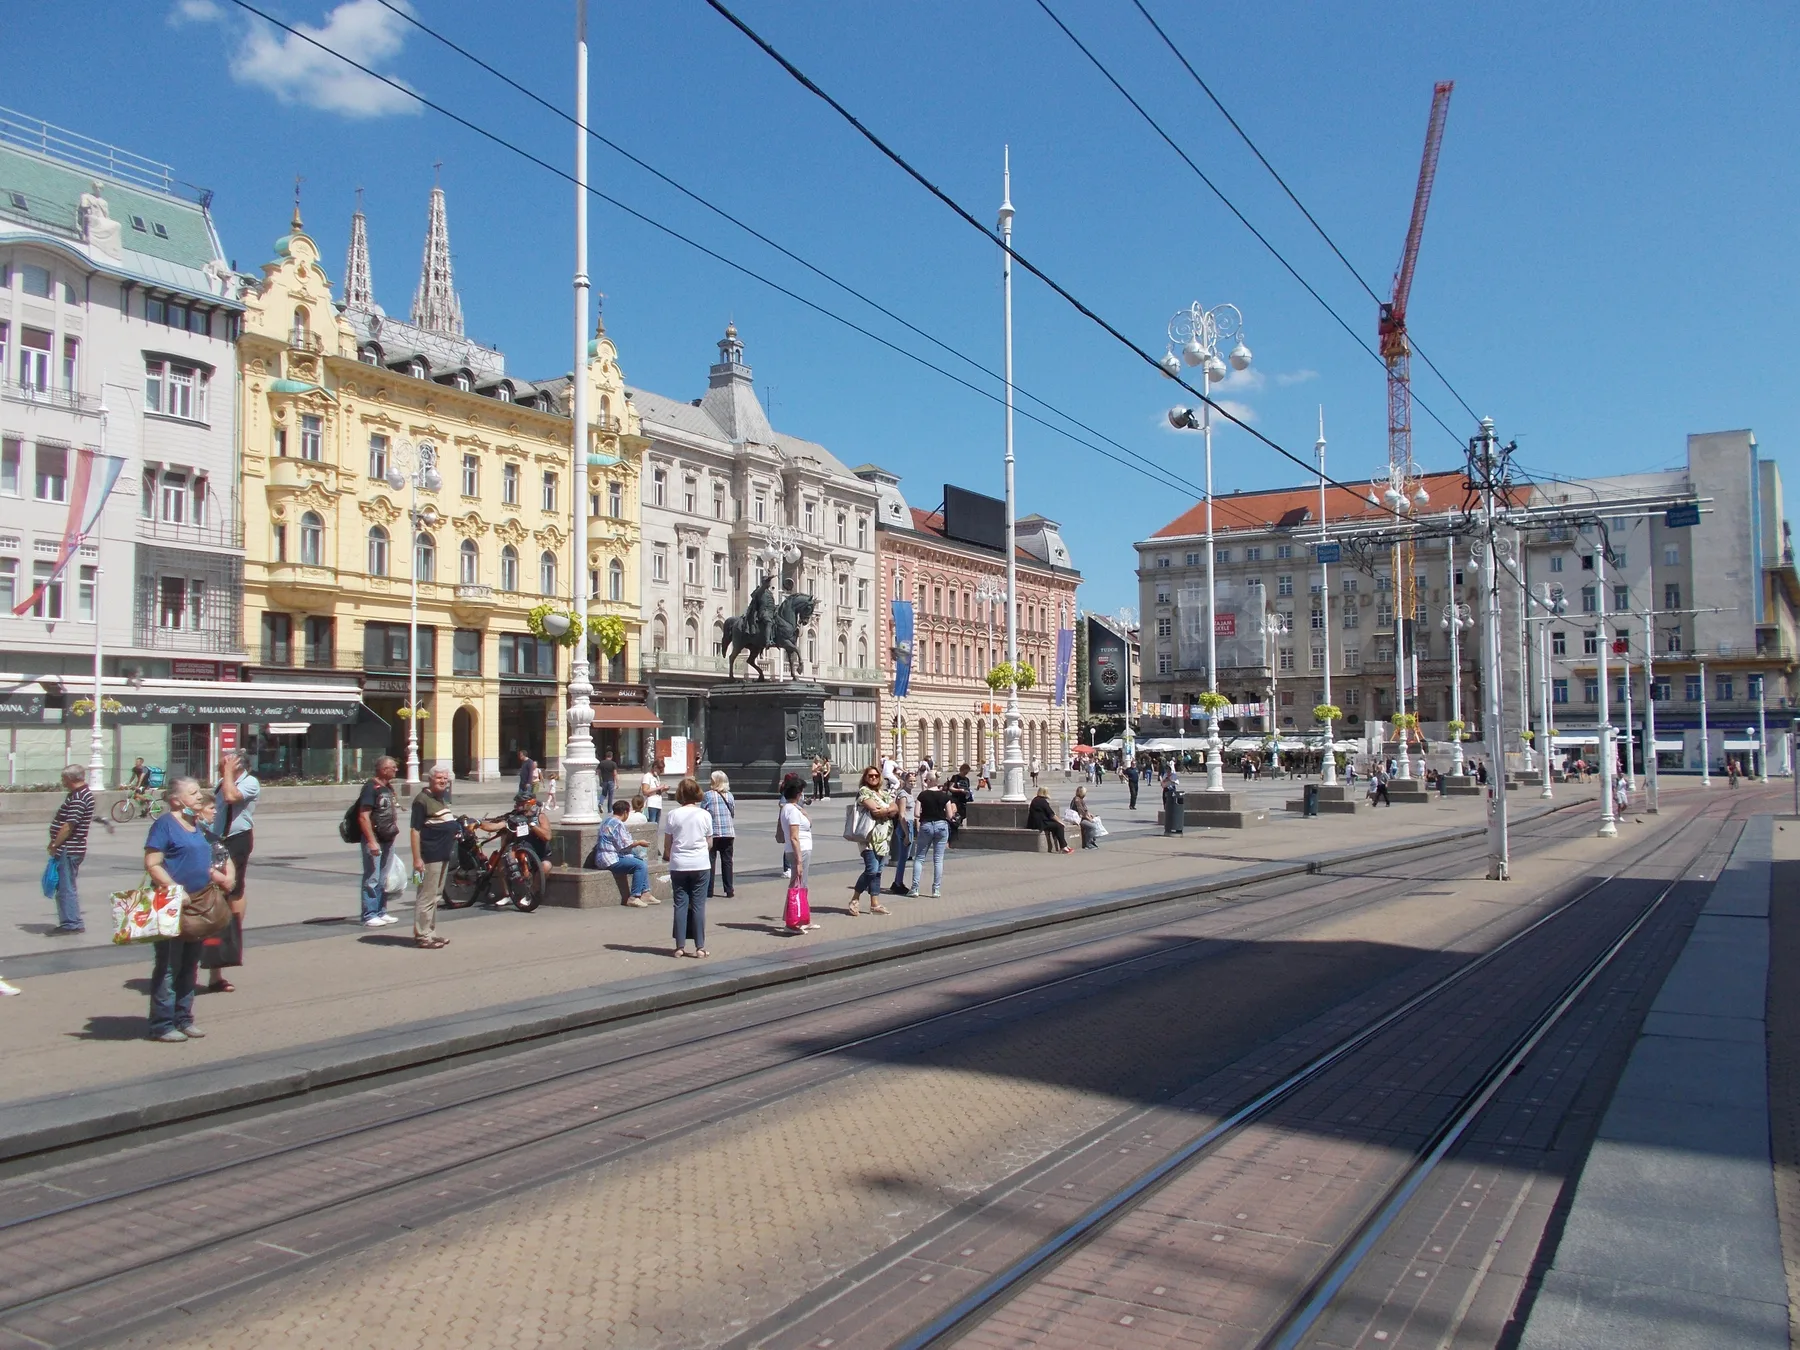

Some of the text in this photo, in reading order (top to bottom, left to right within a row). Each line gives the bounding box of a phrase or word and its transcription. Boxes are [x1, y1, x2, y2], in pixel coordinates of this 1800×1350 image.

[199, 706, 246, 714] MALA KAVANA
[300, 707, 344, 716] MALA KAVANA
